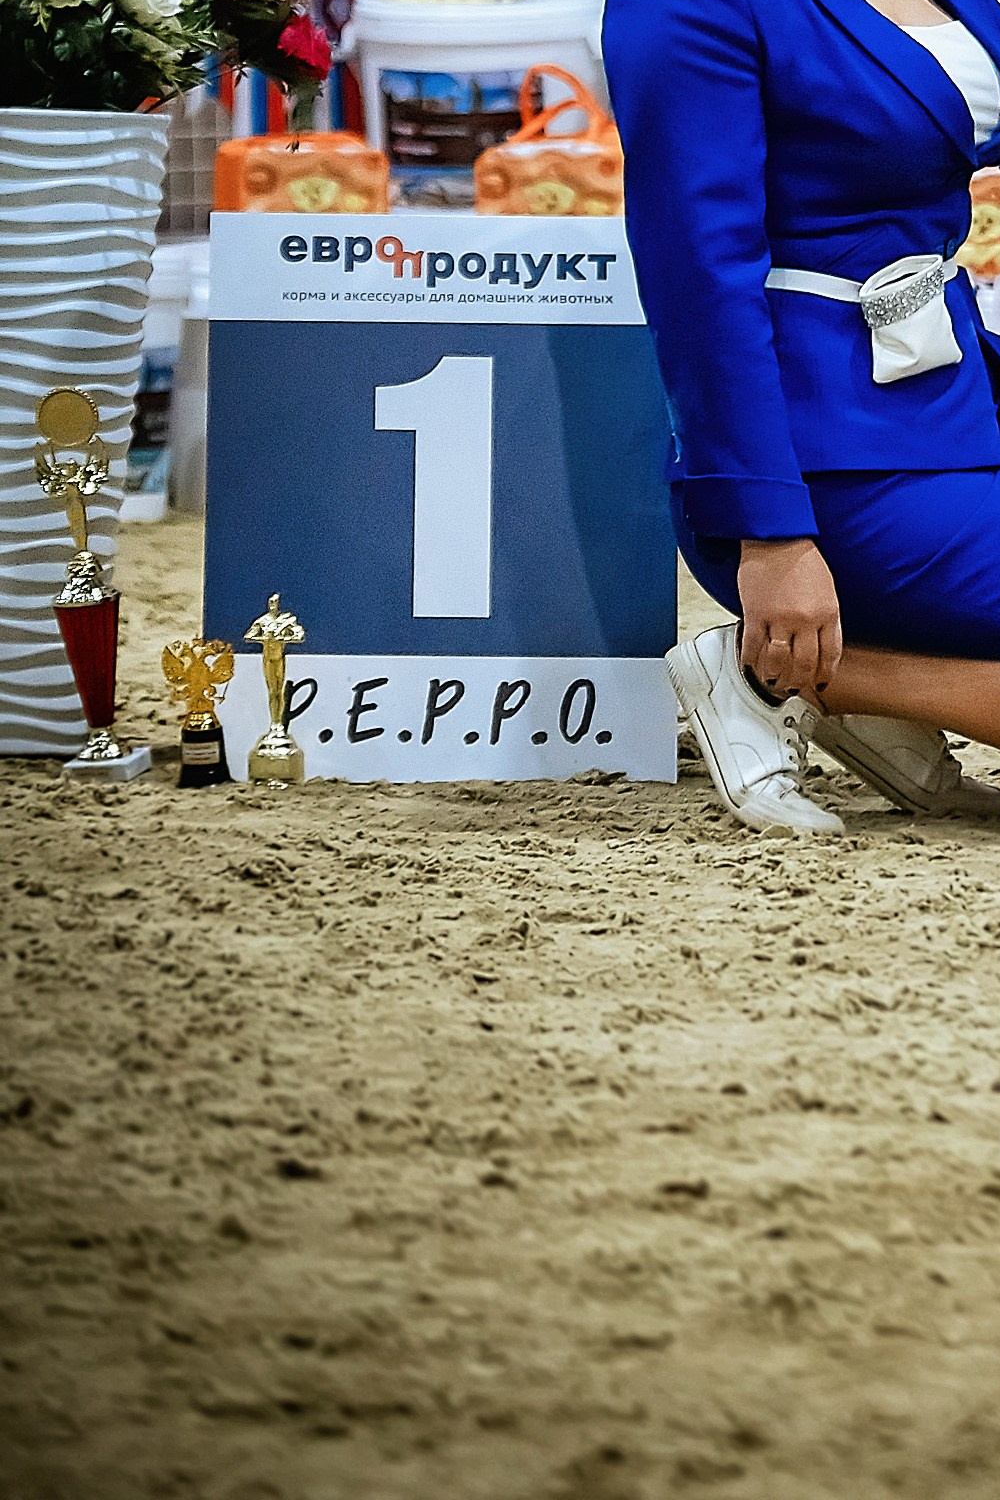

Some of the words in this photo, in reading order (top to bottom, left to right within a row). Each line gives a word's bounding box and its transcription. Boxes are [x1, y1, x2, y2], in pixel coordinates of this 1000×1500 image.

[280, 235, 617, 289] европродукт
[282, 291, 326, 302] корма
[331, 292, 339, 301] и
[344, 292, 425, 304] аксессуары
[428, 293, 453, 303] для
[457, 294, 534, 304] домашних
[538, 295, 613, 304] животных
[375, 356, 492, 618] 1
